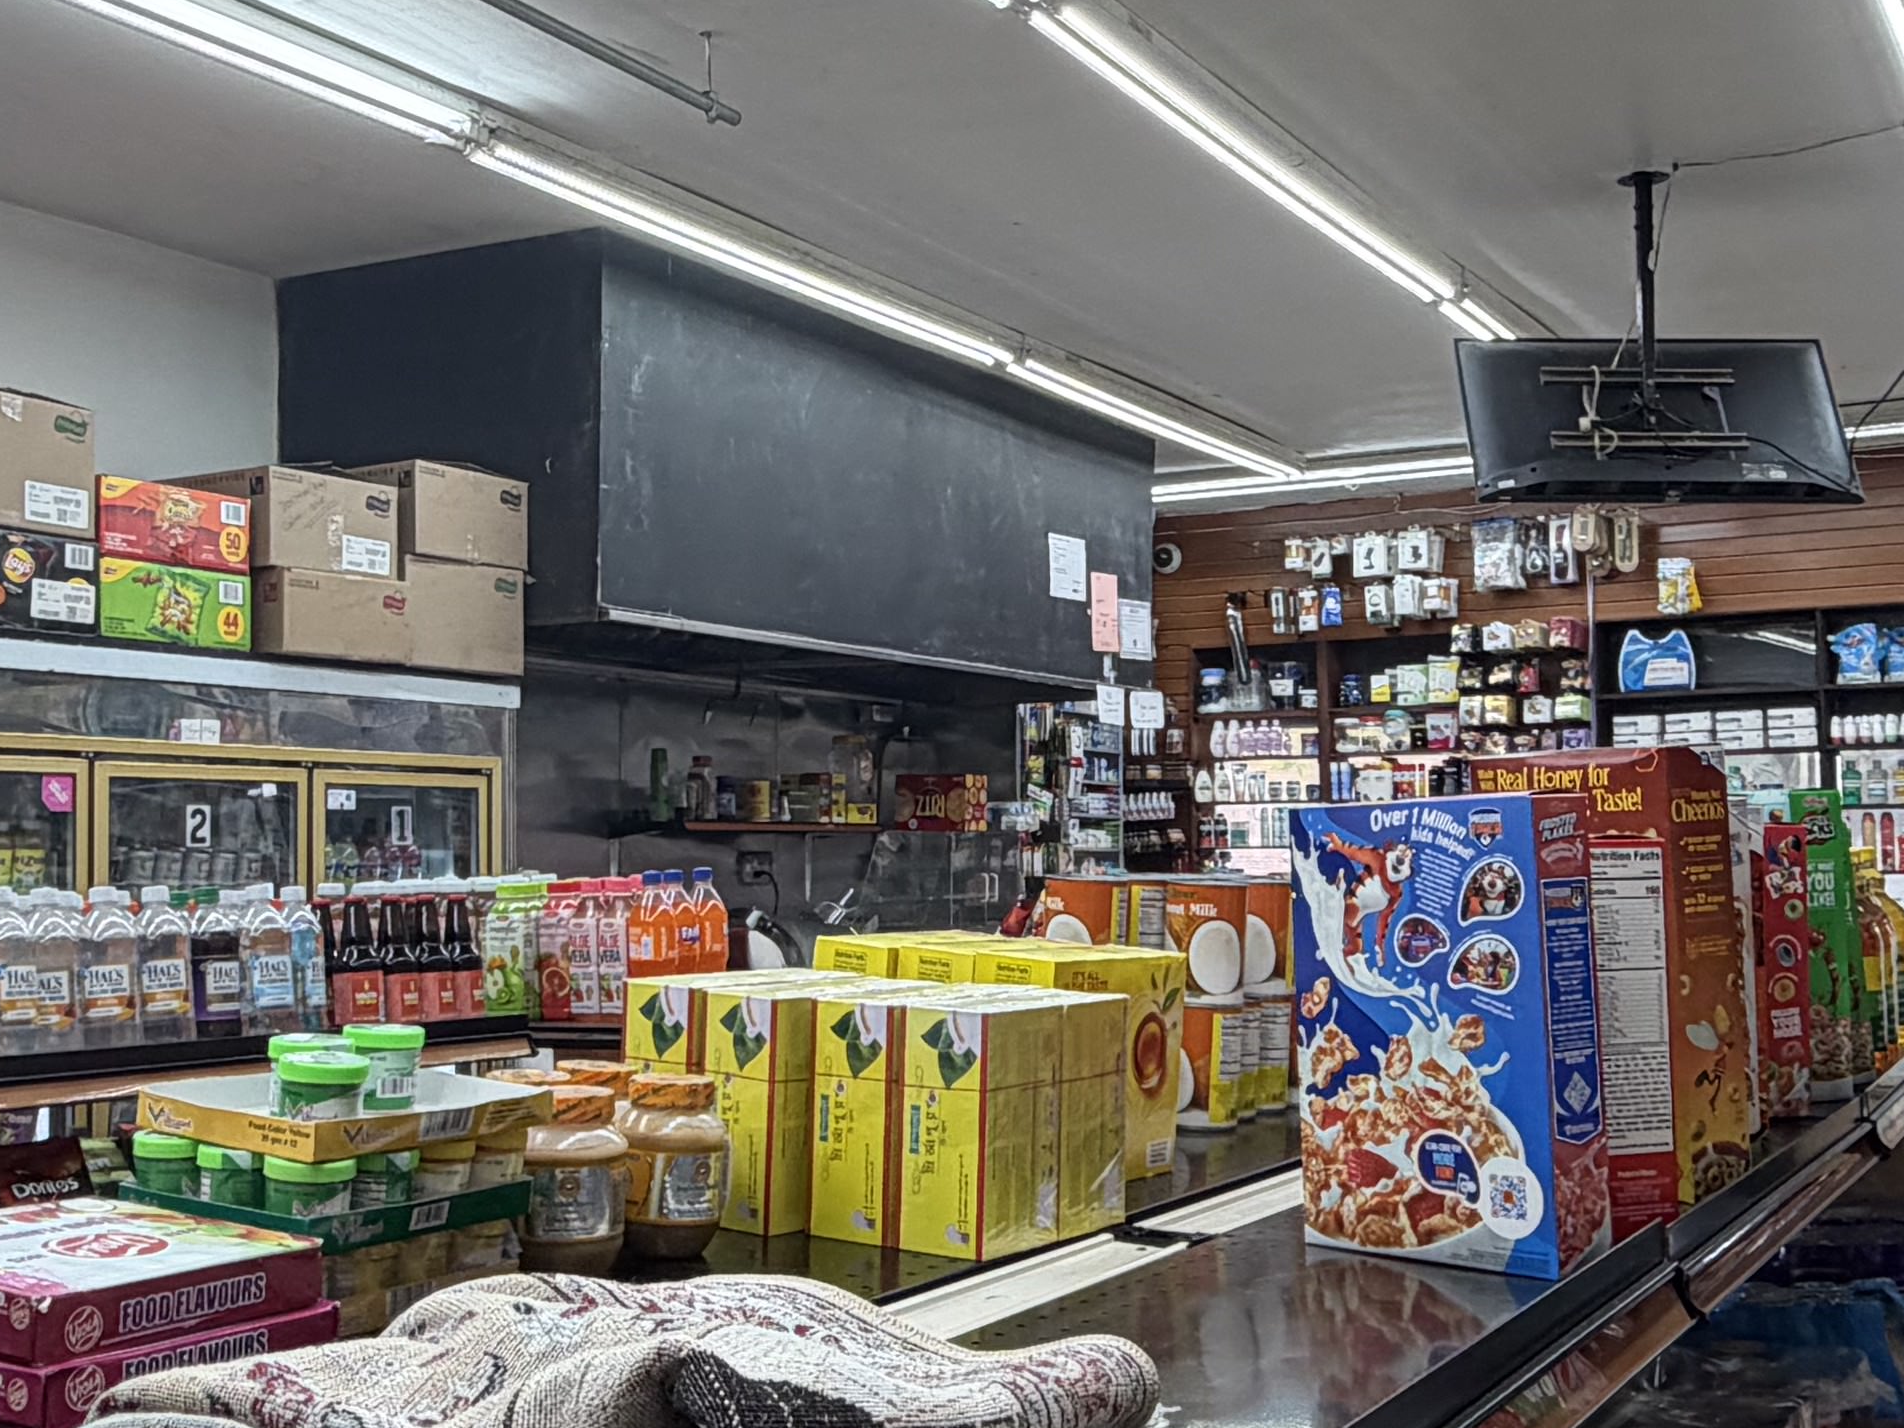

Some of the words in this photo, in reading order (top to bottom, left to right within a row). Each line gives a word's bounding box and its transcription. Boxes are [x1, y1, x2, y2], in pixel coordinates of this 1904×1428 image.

[225, 531, 242, 553] 50
[223, 612, 240, 633] 44
[1496, 766, 1528, 791] Real
[1533, 766, 1584, 793] Honey
[1588, 763, 1611, 787] for
[916, 794, 946, 818] RITZ
[1594, 787, 1643, 812] Taste!
[1671, 798, 1725, 822] Cheerios
[189, 807, 208, 845] 2
[395, 808, 409, 842] 1
[1370, 808, 1409, 833] Over
[1412, 807, 1421, 825] 1
[1421, 807, 1468, 839] Million
[1410, 826, 1435, 845] kids
[1808, 872, 1835, 891] YOU
[1189, 903, 1218, 918] Milk
[599, 933, 621, 948] ALOE
[570, 950, 592, 964] VERA
[599, 950, 621, 964] VERA
[146, 961, 182, 979] HAL'S
[11, 1176, 80, 1200] Doritos
[119, 1293, 175, 1333] FOOD
[174, 1272, 267, 1320] FLAVOURS
[174, 1329, 269, 1368] FLAVOURS
